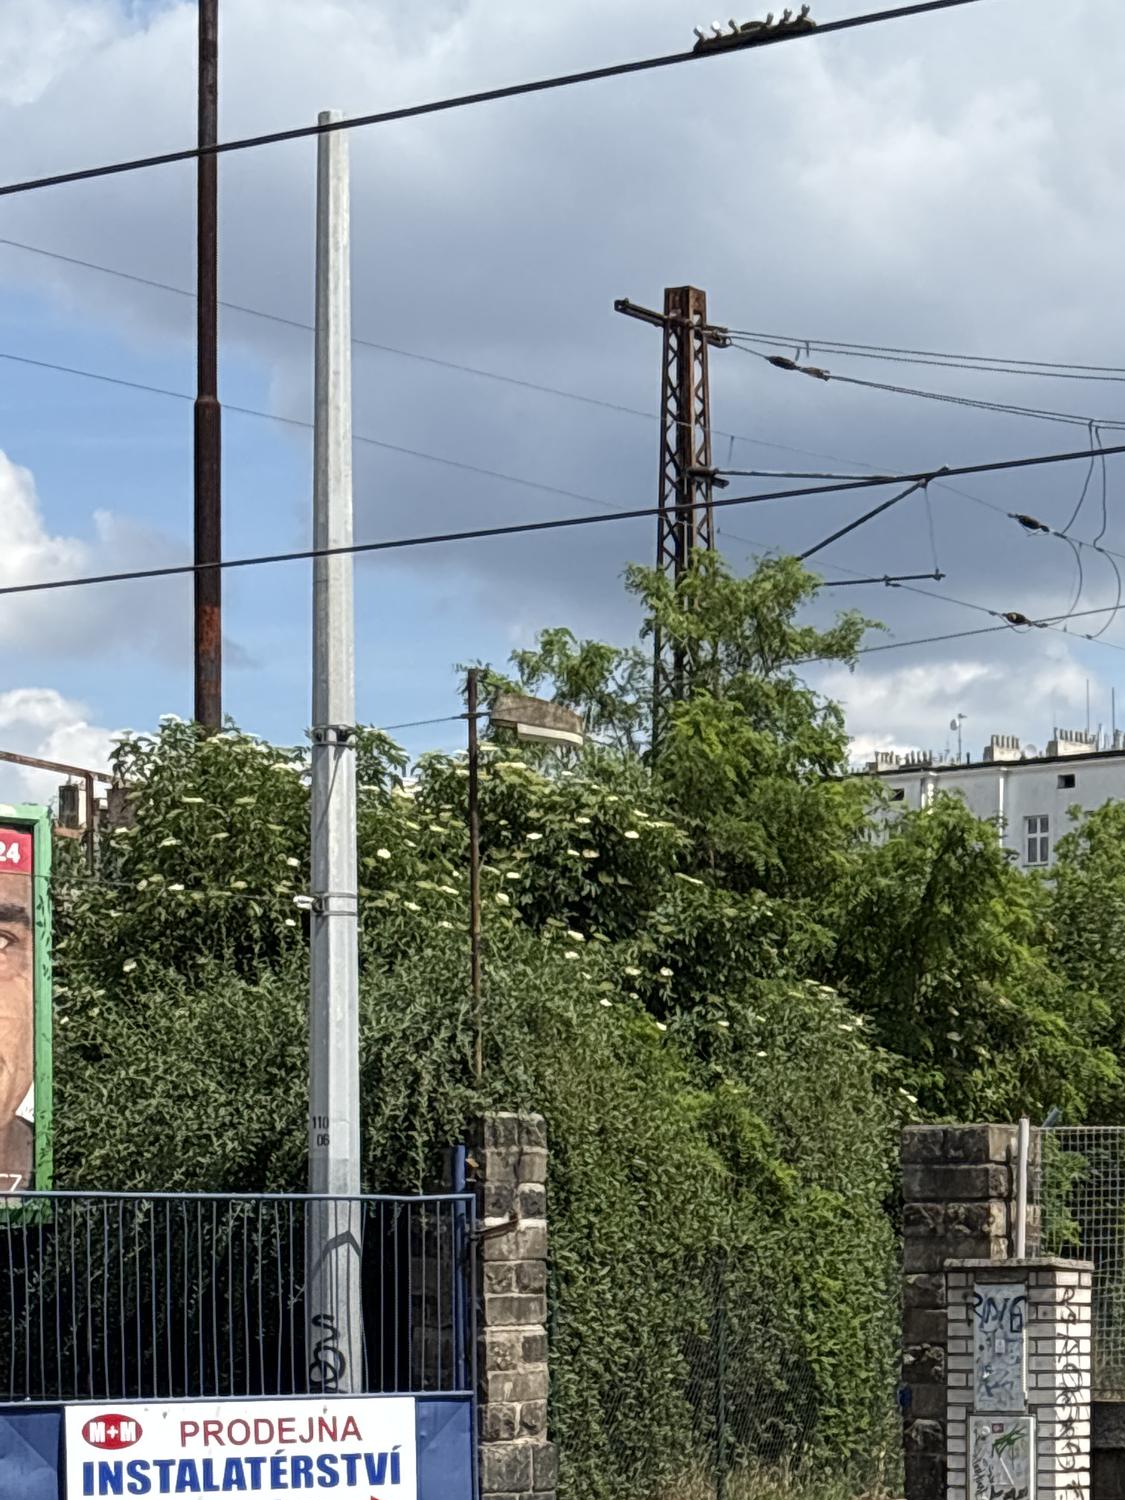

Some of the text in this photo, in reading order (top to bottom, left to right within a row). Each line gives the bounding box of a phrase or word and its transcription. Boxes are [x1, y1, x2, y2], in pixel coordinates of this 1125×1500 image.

[312, 1116, 330, 1129] 110
[316, 1133, 330, 1147] 06
[89, 1420, 137, 1443] M+M
[180, 1415, 363, 1448] PRODEJNA
[82, 1444, 402, 1496] INSTALATÉRSTVÍ
